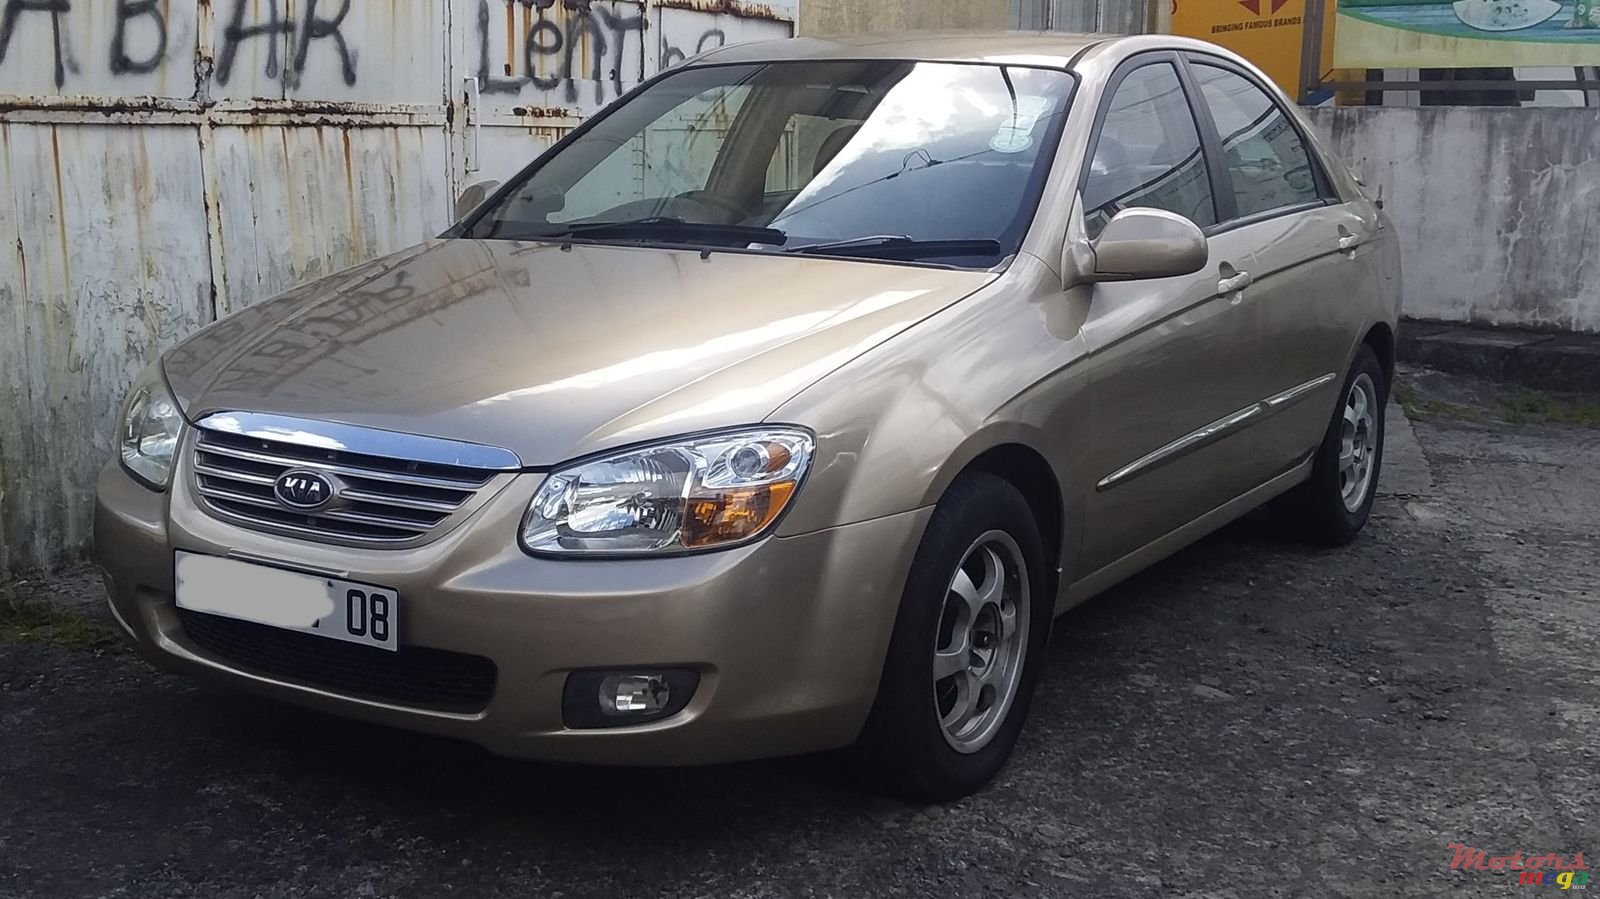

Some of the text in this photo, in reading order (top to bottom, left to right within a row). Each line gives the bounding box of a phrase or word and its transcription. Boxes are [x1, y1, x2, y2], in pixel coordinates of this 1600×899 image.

[1211, 16, 1301, 34] BRINGING FAMOUS BRANDS
[346, 589, 389, 641] 08
